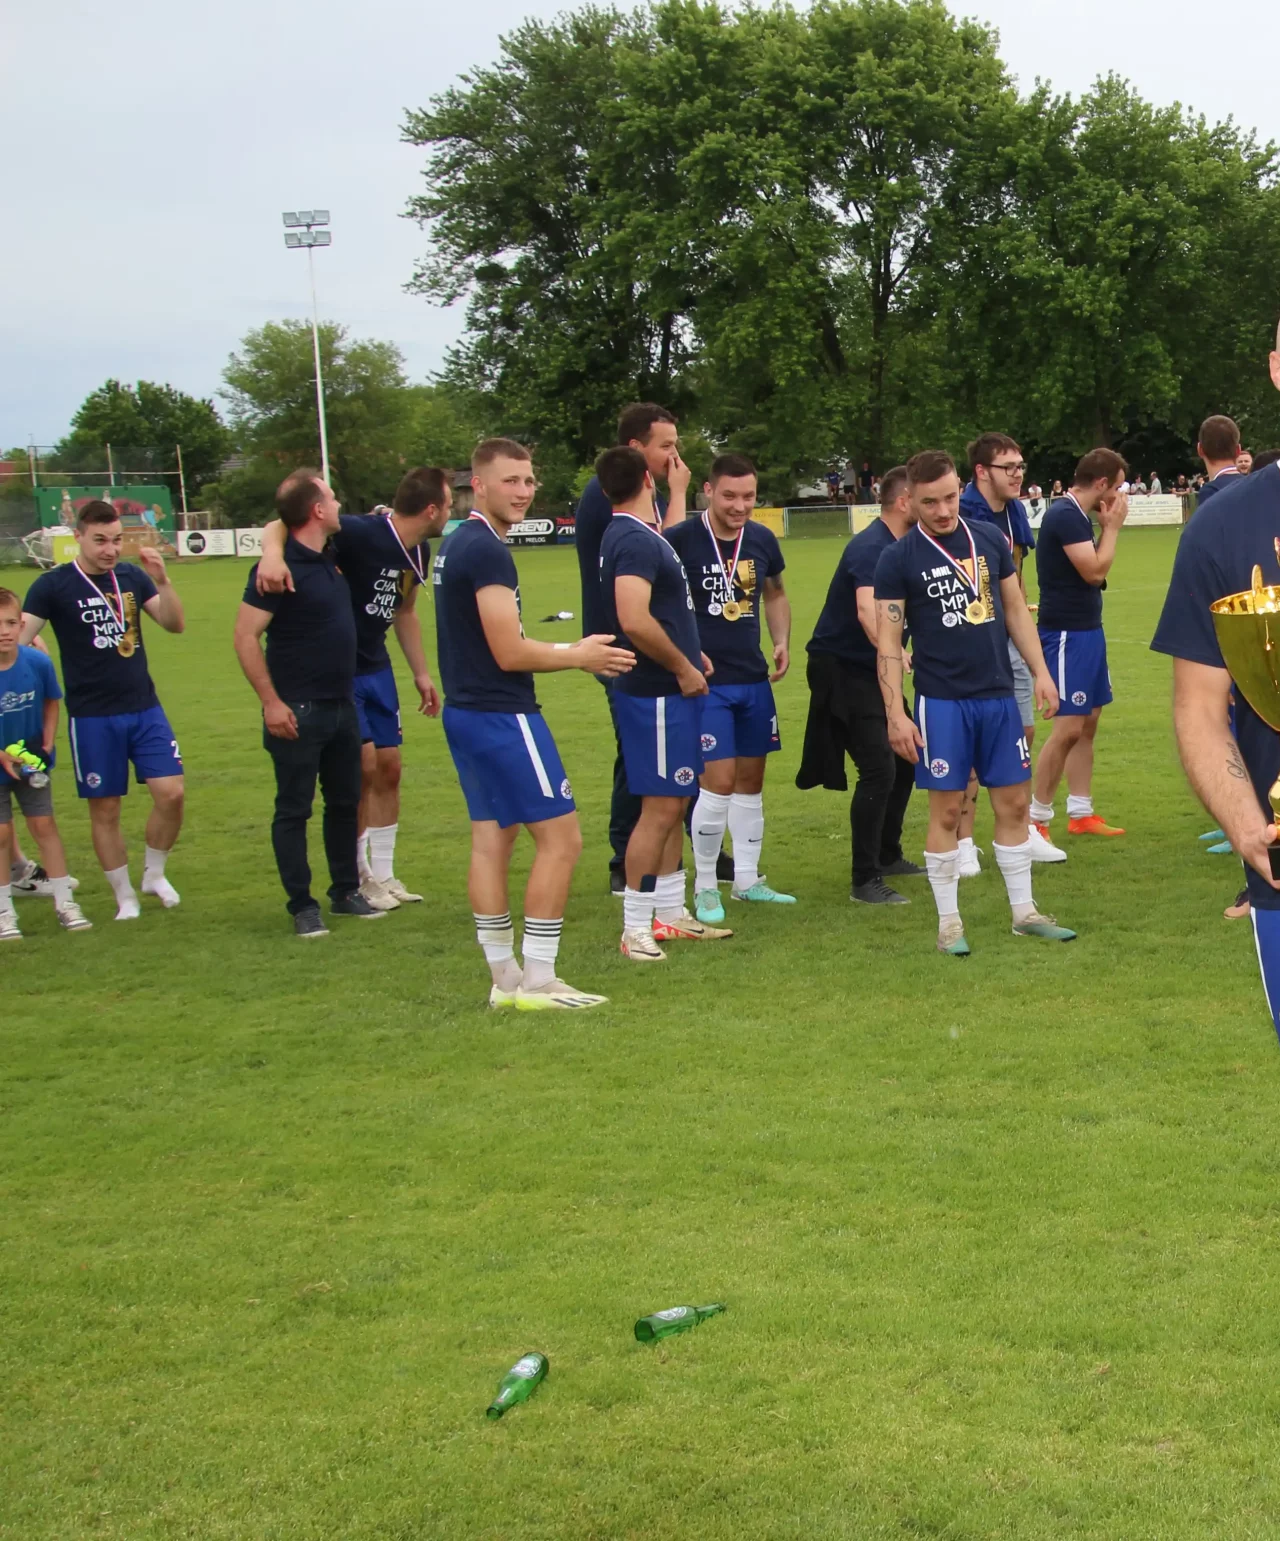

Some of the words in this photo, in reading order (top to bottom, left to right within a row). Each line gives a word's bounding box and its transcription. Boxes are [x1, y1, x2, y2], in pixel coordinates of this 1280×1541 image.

[921, 571, 932, 582] 1.
[931, 565, 953, 578] MNL
[373, 579, 397, 593] CHA
[926, 577, 965, 598] CHA
[977, 555, 996, 618] DUBRAVČAN
[373, 593, 396, 607] MPI
[170, 740, 182, 758] 2
